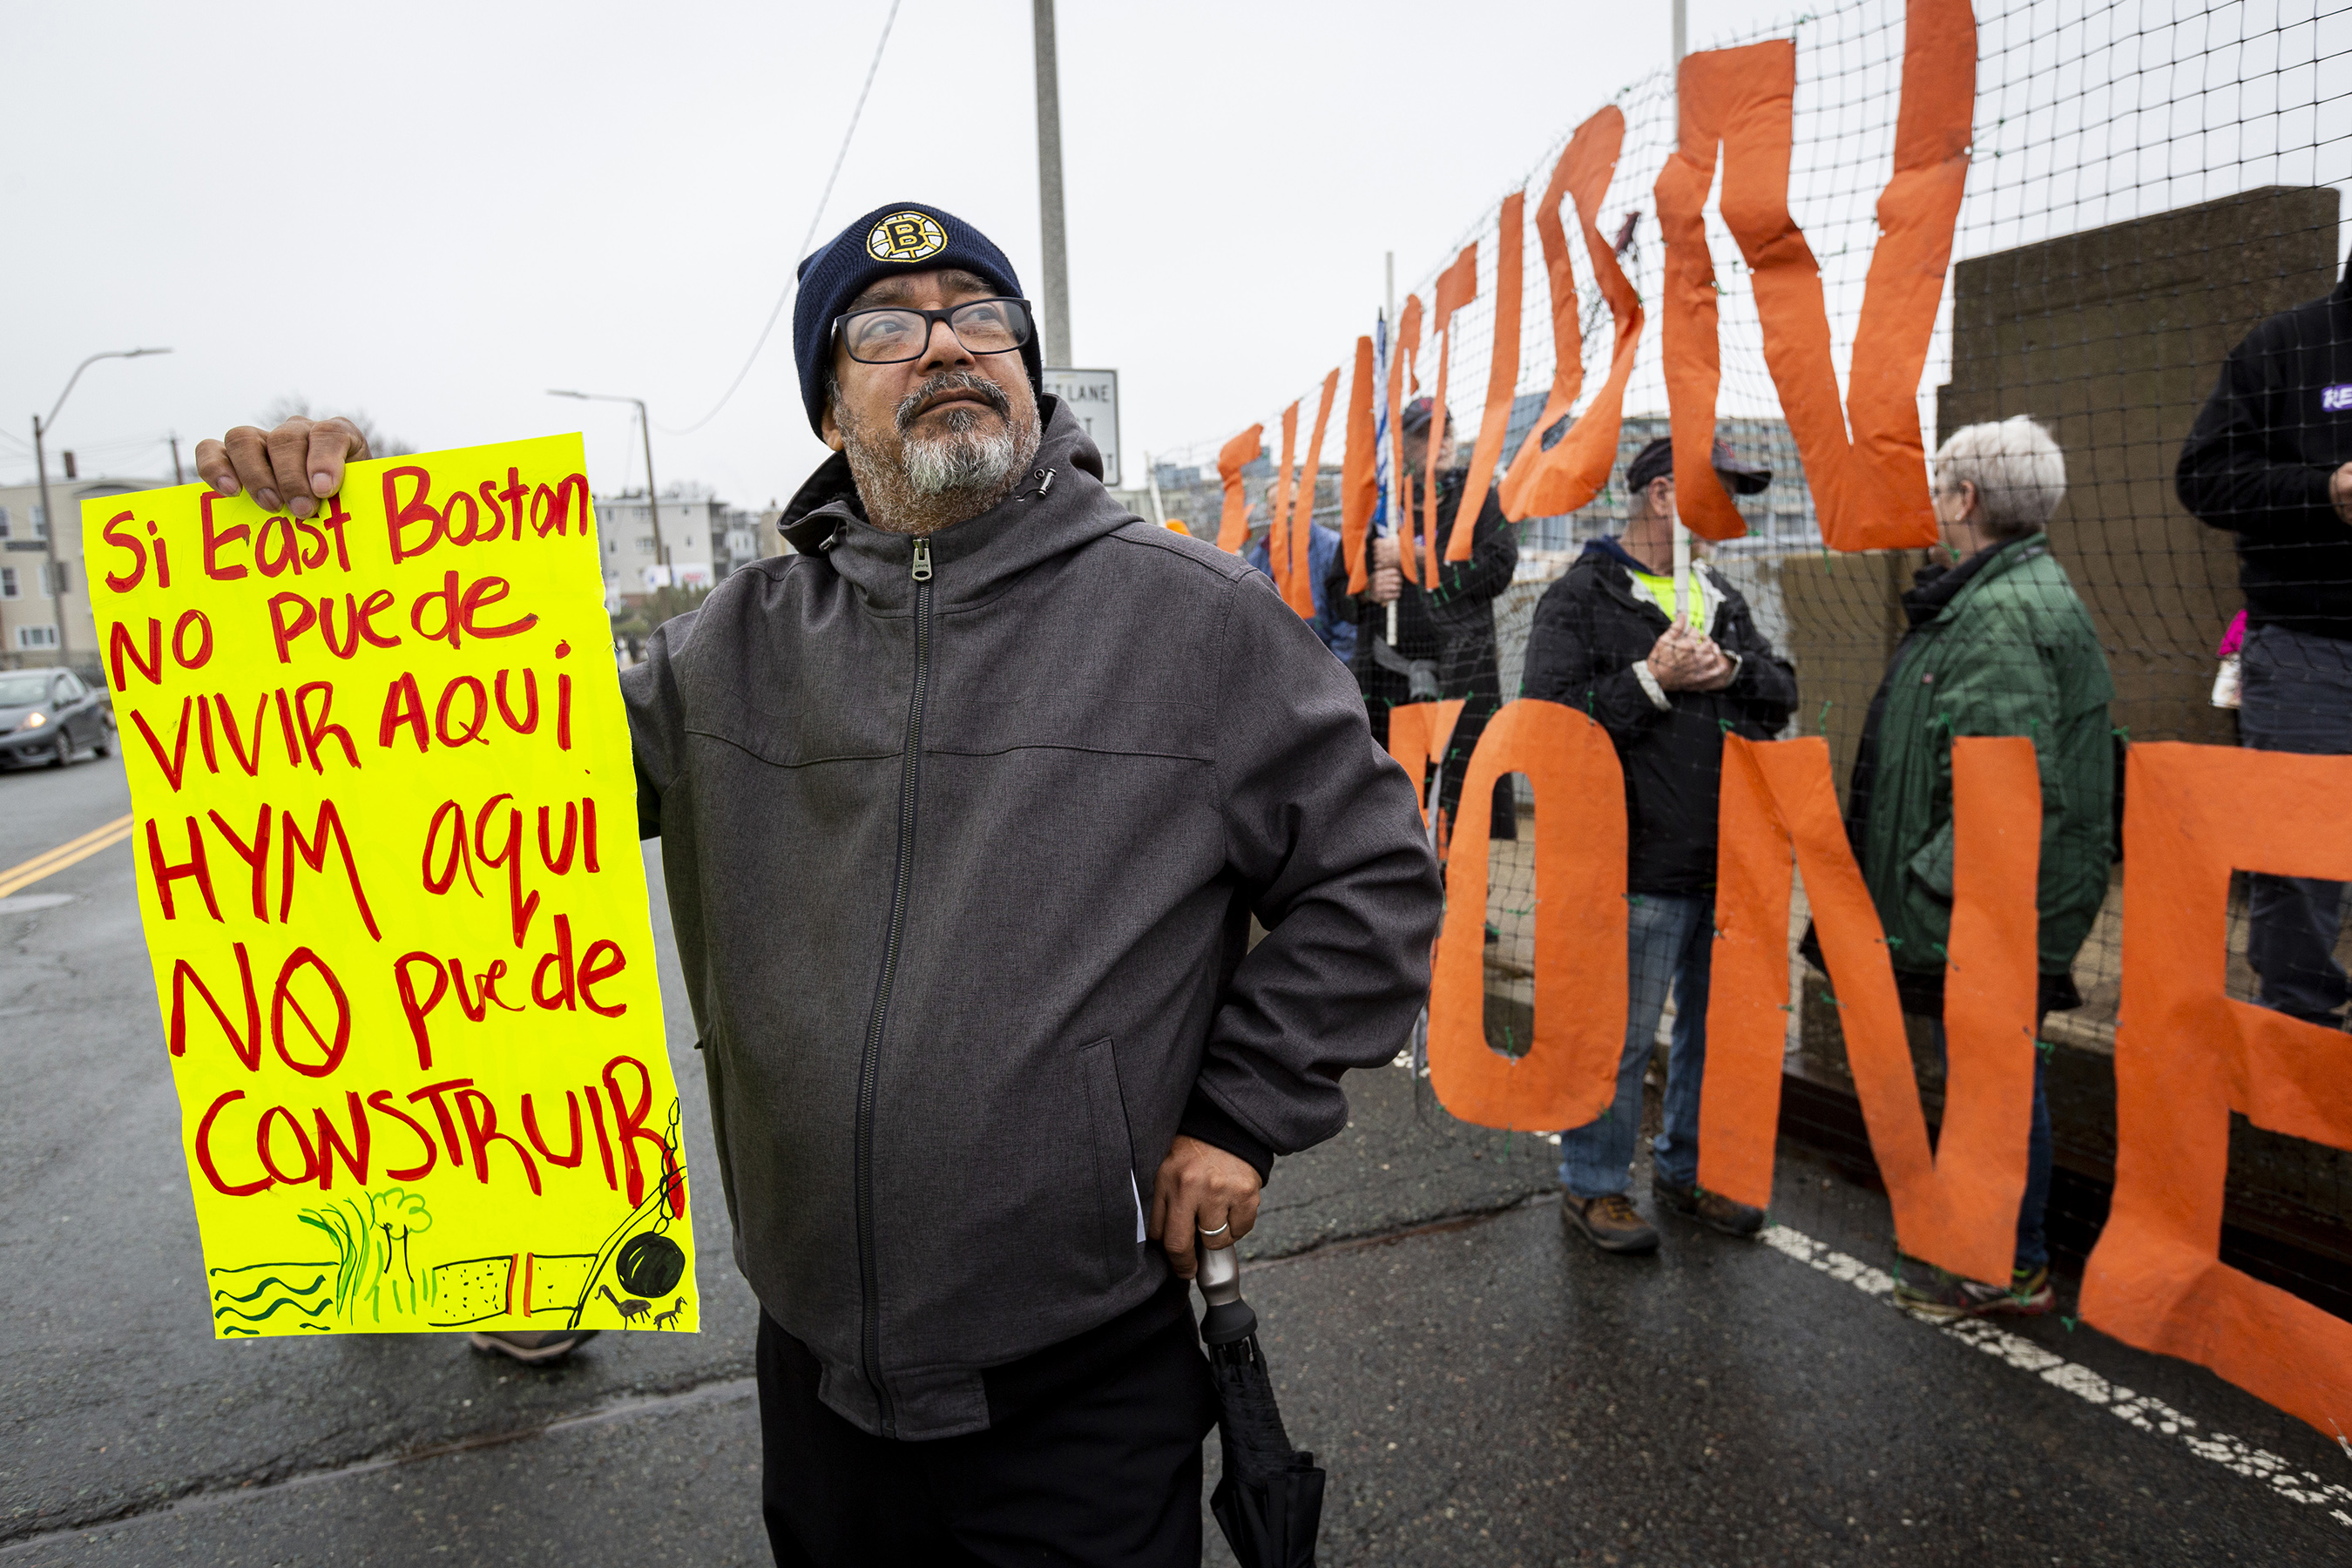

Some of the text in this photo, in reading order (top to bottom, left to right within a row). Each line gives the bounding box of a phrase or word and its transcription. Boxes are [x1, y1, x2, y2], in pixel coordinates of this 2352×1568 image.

[883, 217, 929, 254] B
[1066, 384, 1111, 402] LANE
[103, 465, 589, 593] Si East Boston
[110, 609, 213, 693] NO
[130, 681, 362, 793] VIVIR
[145, 798, 382, 943] HYM
[170, 913, 627, 1078] NO puede
[195, 1055, 686, 1221] CONSTRUIR
